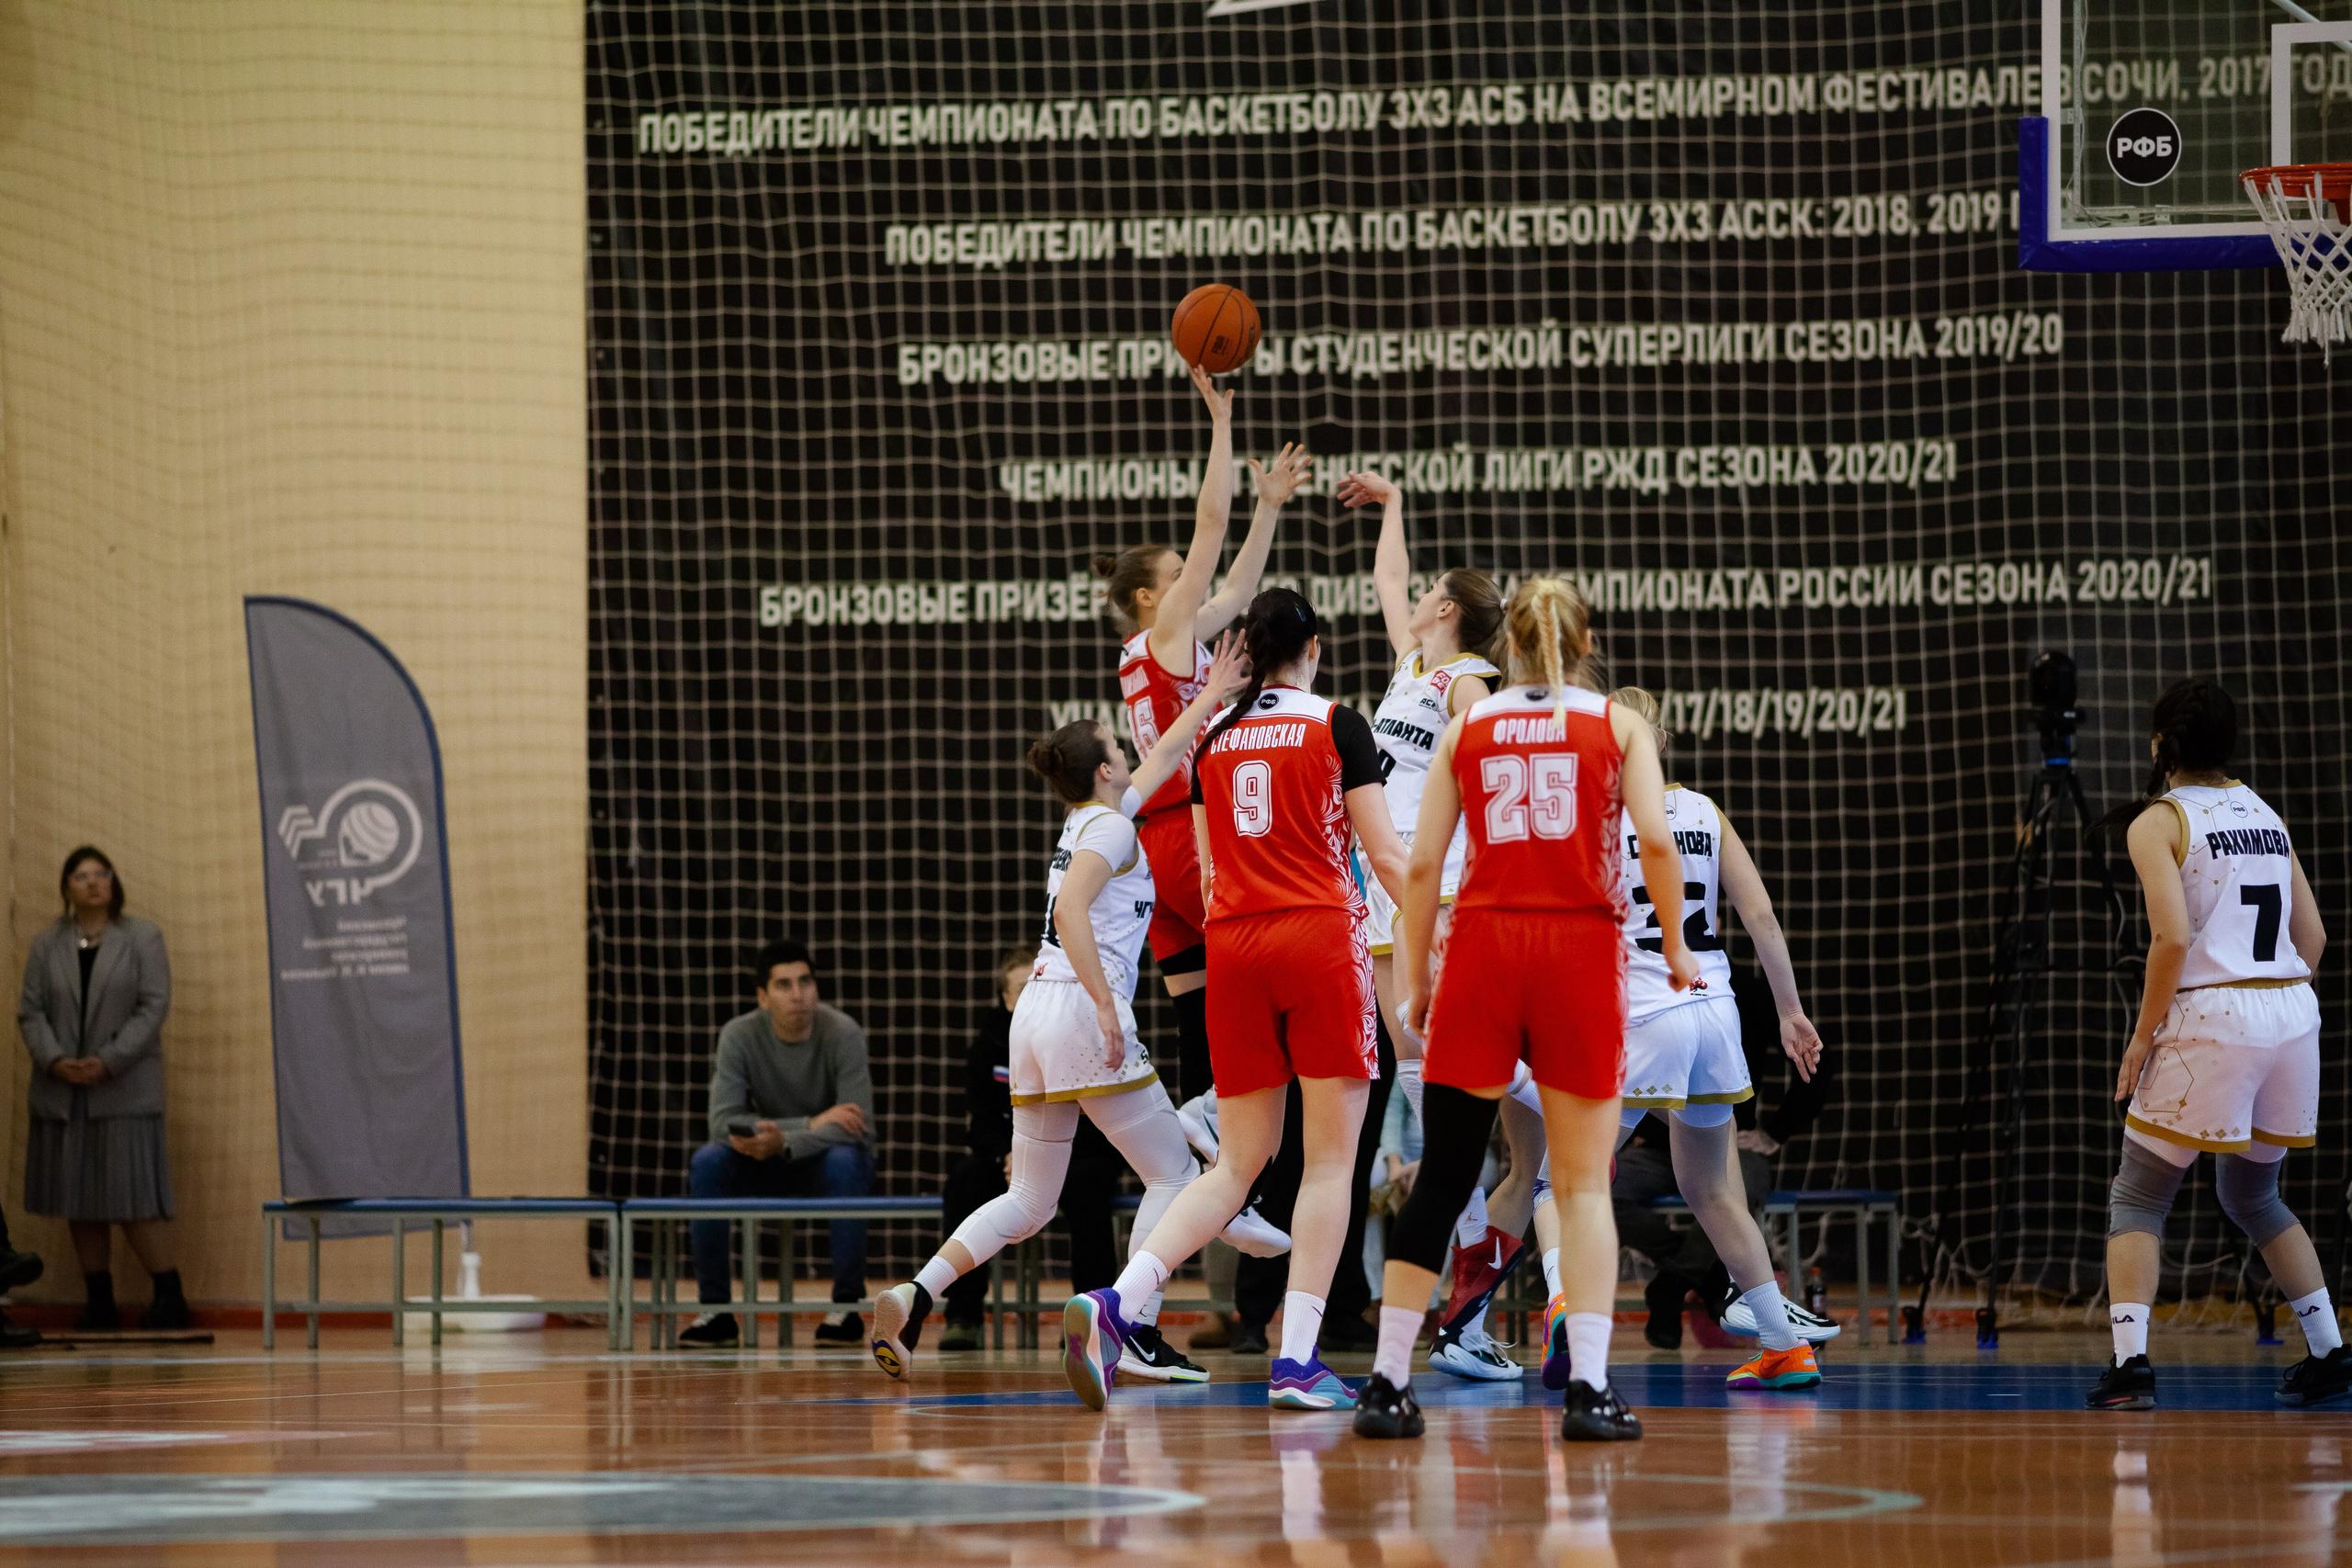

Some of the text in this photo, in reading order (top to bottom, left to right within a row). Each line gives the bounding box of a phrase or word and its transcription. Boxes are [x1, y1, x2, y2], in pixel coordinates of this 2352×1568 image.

[639, 107, 860, 156] ПОБЕДИТЕЛИ
[866, 99, 1099, 147] ЧЕМПИОНАТА
[1105, 98, 1151, 141] ПО
[1159, 92, 1382, 138] БАСКЕТБОЛУ
[1455, 85, 1527, 128] АСБ
[1532, 84, 1582, 124] НА
[1589, 73, 1816, 123] ВСЕМИРНОМ
[1823, 65, 2042, 114] ФЕСТИВАЛЕ
[2198, 54, 2271, 100] 2017
[2117, 136, 2173, 158] РФБ
[885, 220, 1114, 269] ПОБЕДИТЕЛИ
[1121, 211, 1350, 259] ЧЕМПИОНАТА
[1360, 210, 1409, 253] ПО
[1415, 204, 1642, 251] БАСКЕТБОЛУ
[1718, 197, 1826, 241] АССК:
[1928, 191, 2002, 235] 2019
[897, 341, 1110, 386] БРОНЗОВЫЕ
[1116, 336, 1285, 380] ПРИЫ
[1291, 317, 1562, 380] СТУДЕНЧЕСКОЙ
[1567, 321, 1776, 367] СУПЕРЛИГИ
[1783, 318, 1927, 363] СЕЗОНА
[1934, 311, 2064, 362] 2019/20
[1000, 458, 1197, 503] ЧЕМПИОНЫ
[1480, 448, 1578, 493] ЛИГИ
[1582, 446, 1670, 495] РЖД
[1675, 444, 1818, 490] СЕЗОНА
[1825, 436, 1957, 490] 2020/21
[759, 582, 969, 628] БРОНЗОВЫЕ
[975, 570, 1108, 623] ПРИЗЁР
[1534, 568, 1772, 614] МПИОНАТА
[1778, 566, 1924, 610] РОССИИ
[1930, 561, 2071, 606] СЕЗОНА
[2076, 554, 2212, 607] 2020/21
[1232, 759, 1272, 838] 9
[1480, 752, 1579, 845] 25
[2205, 828, 2290, 860] РАХИМОВА
[2240, 883, 2283, 963] 7
